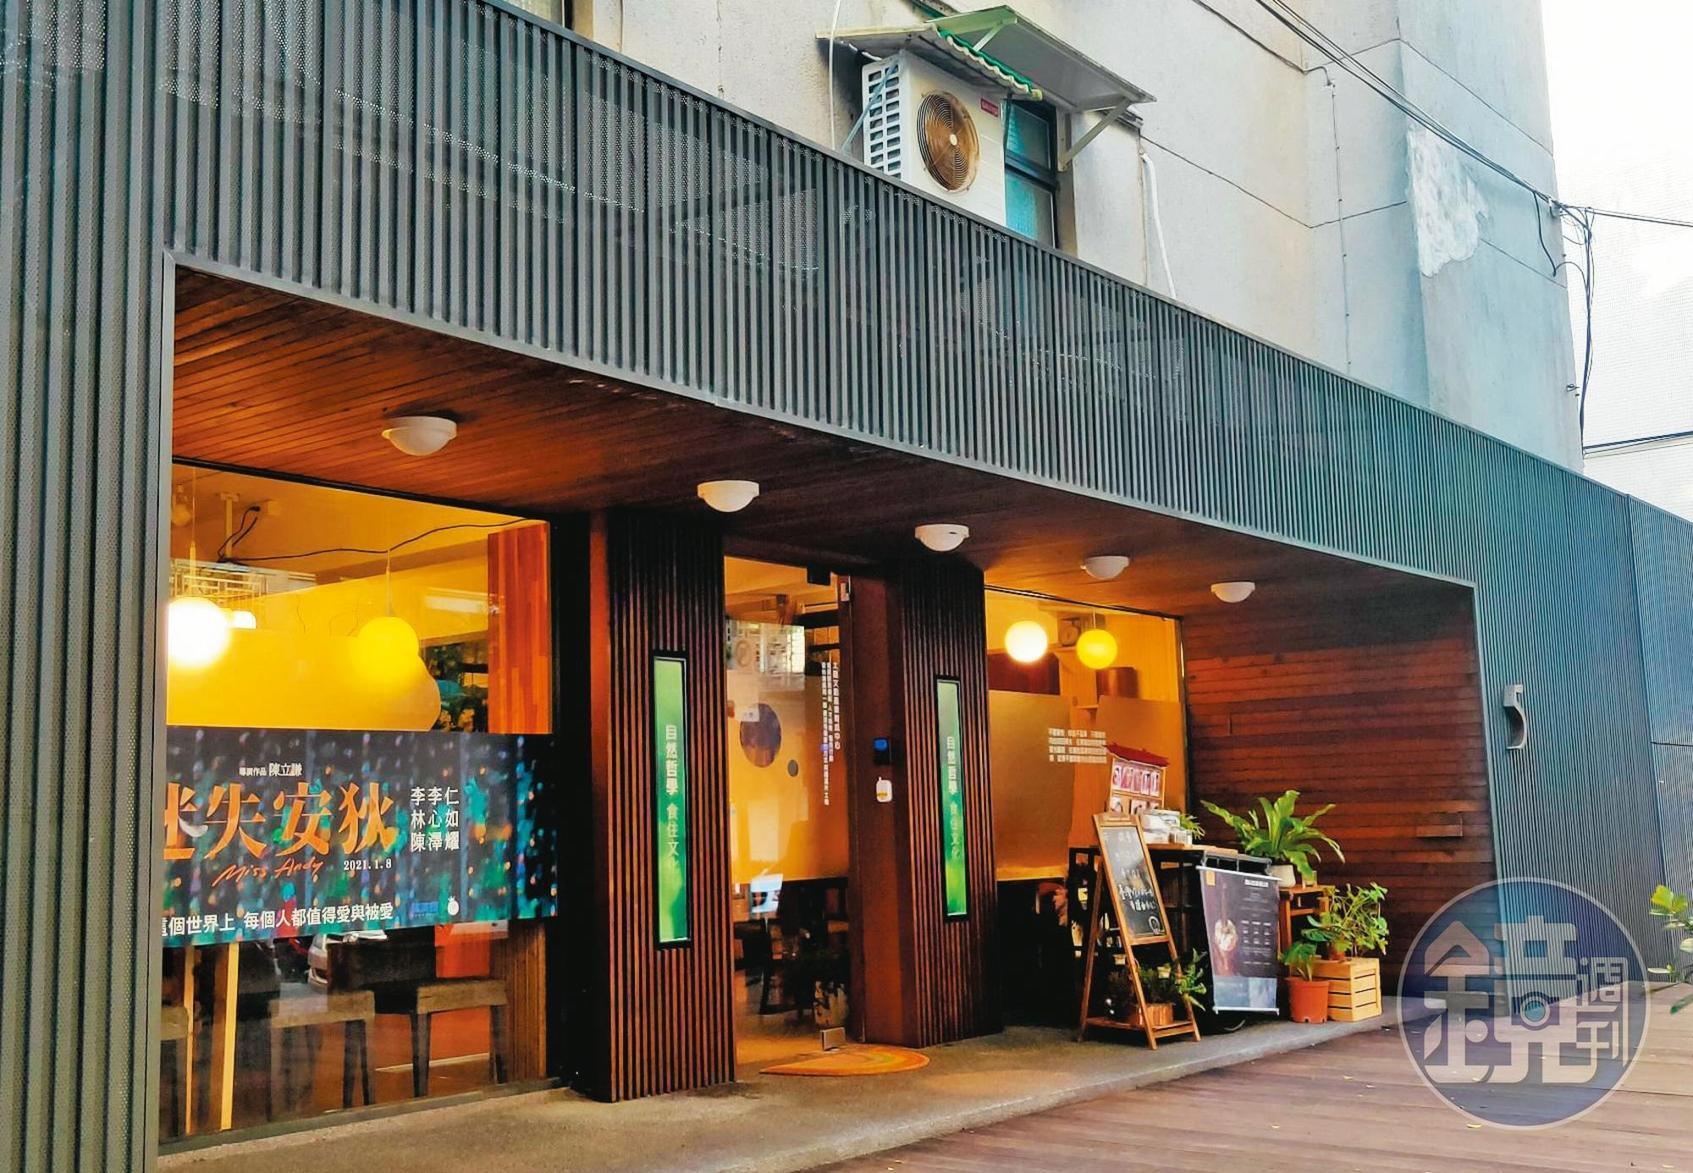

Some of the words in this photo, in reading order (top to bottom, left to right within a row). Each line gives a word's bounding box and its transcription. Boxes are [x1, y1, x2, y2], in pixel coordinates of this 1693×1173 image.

[410, 786, 460, 806] 李李仁
[410, 809, 459, 829] 林心如
[410, 831, 460, 852] 陳澤耀
[211, 864, 268, 888] Miss
[274, 856, 325, 879] Andy
[343, 858, 393, 871] 2021.1.8
[243, 902, 394, 930] 每個人都值得愛與被愛
